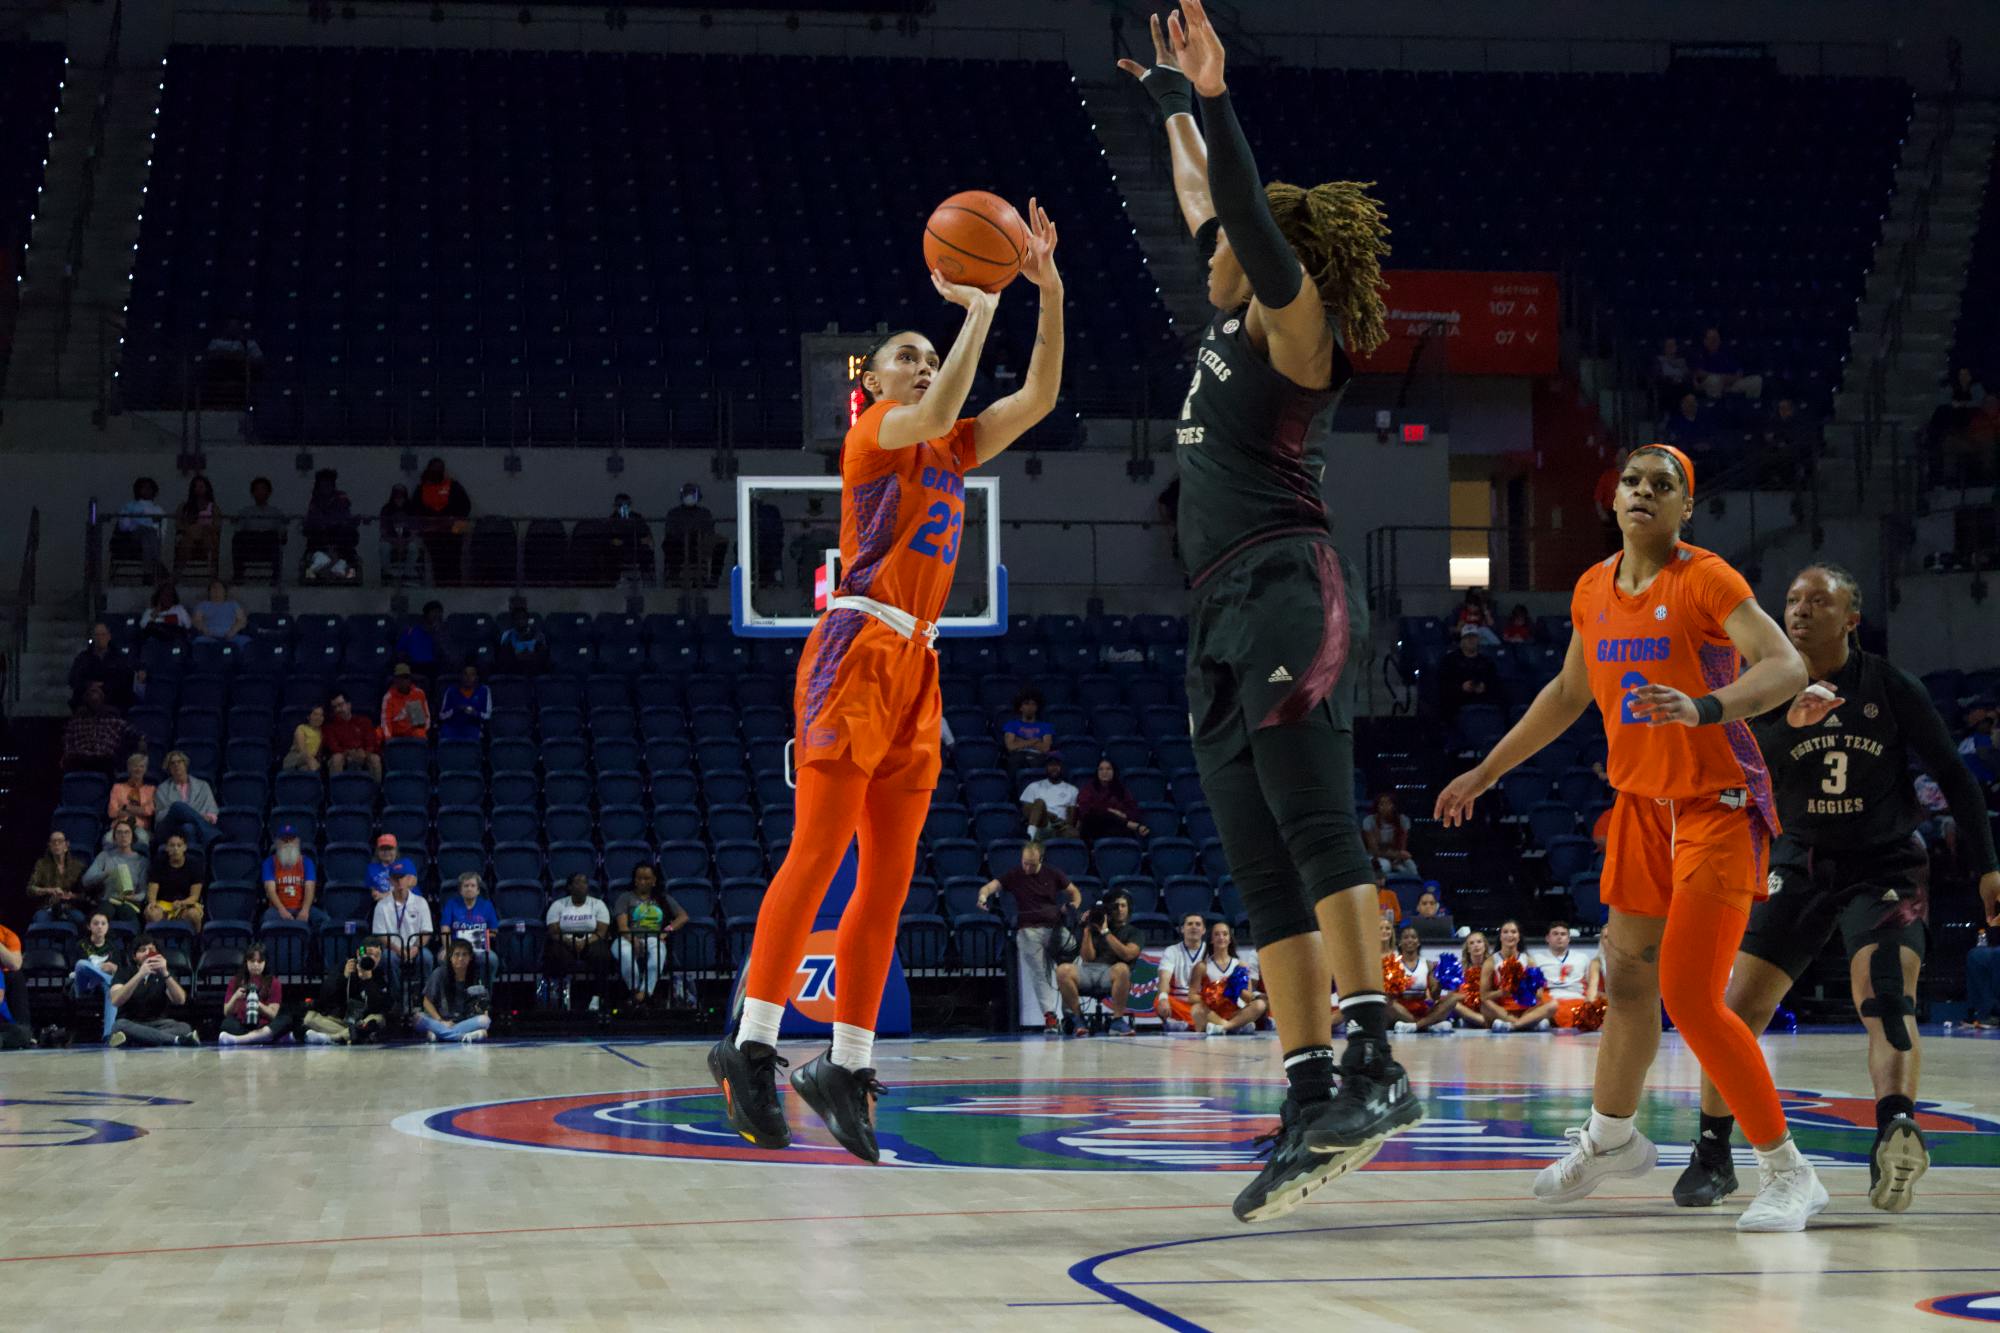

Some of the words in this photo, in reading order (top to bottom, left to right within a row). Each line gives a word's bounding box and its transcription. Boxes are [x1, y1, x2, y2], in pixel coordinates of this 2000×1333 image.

[1490, 301, 1515, 315] 107
[1495, 330, 1516, 345] 07
[1200, 349, 1232, 382] TEXAS
[908, 501, 962, 565] 23
[1597, 636, 1671, 662] GATORS
[1620, 671, 1652, 725] 2
[1844, 735, 1884, 757] TEXAS
[1822, 751, 1848, 795] 3
[1807, 798, 1864, 814] AGGIES
[795, 954, 837, 1002] 7
